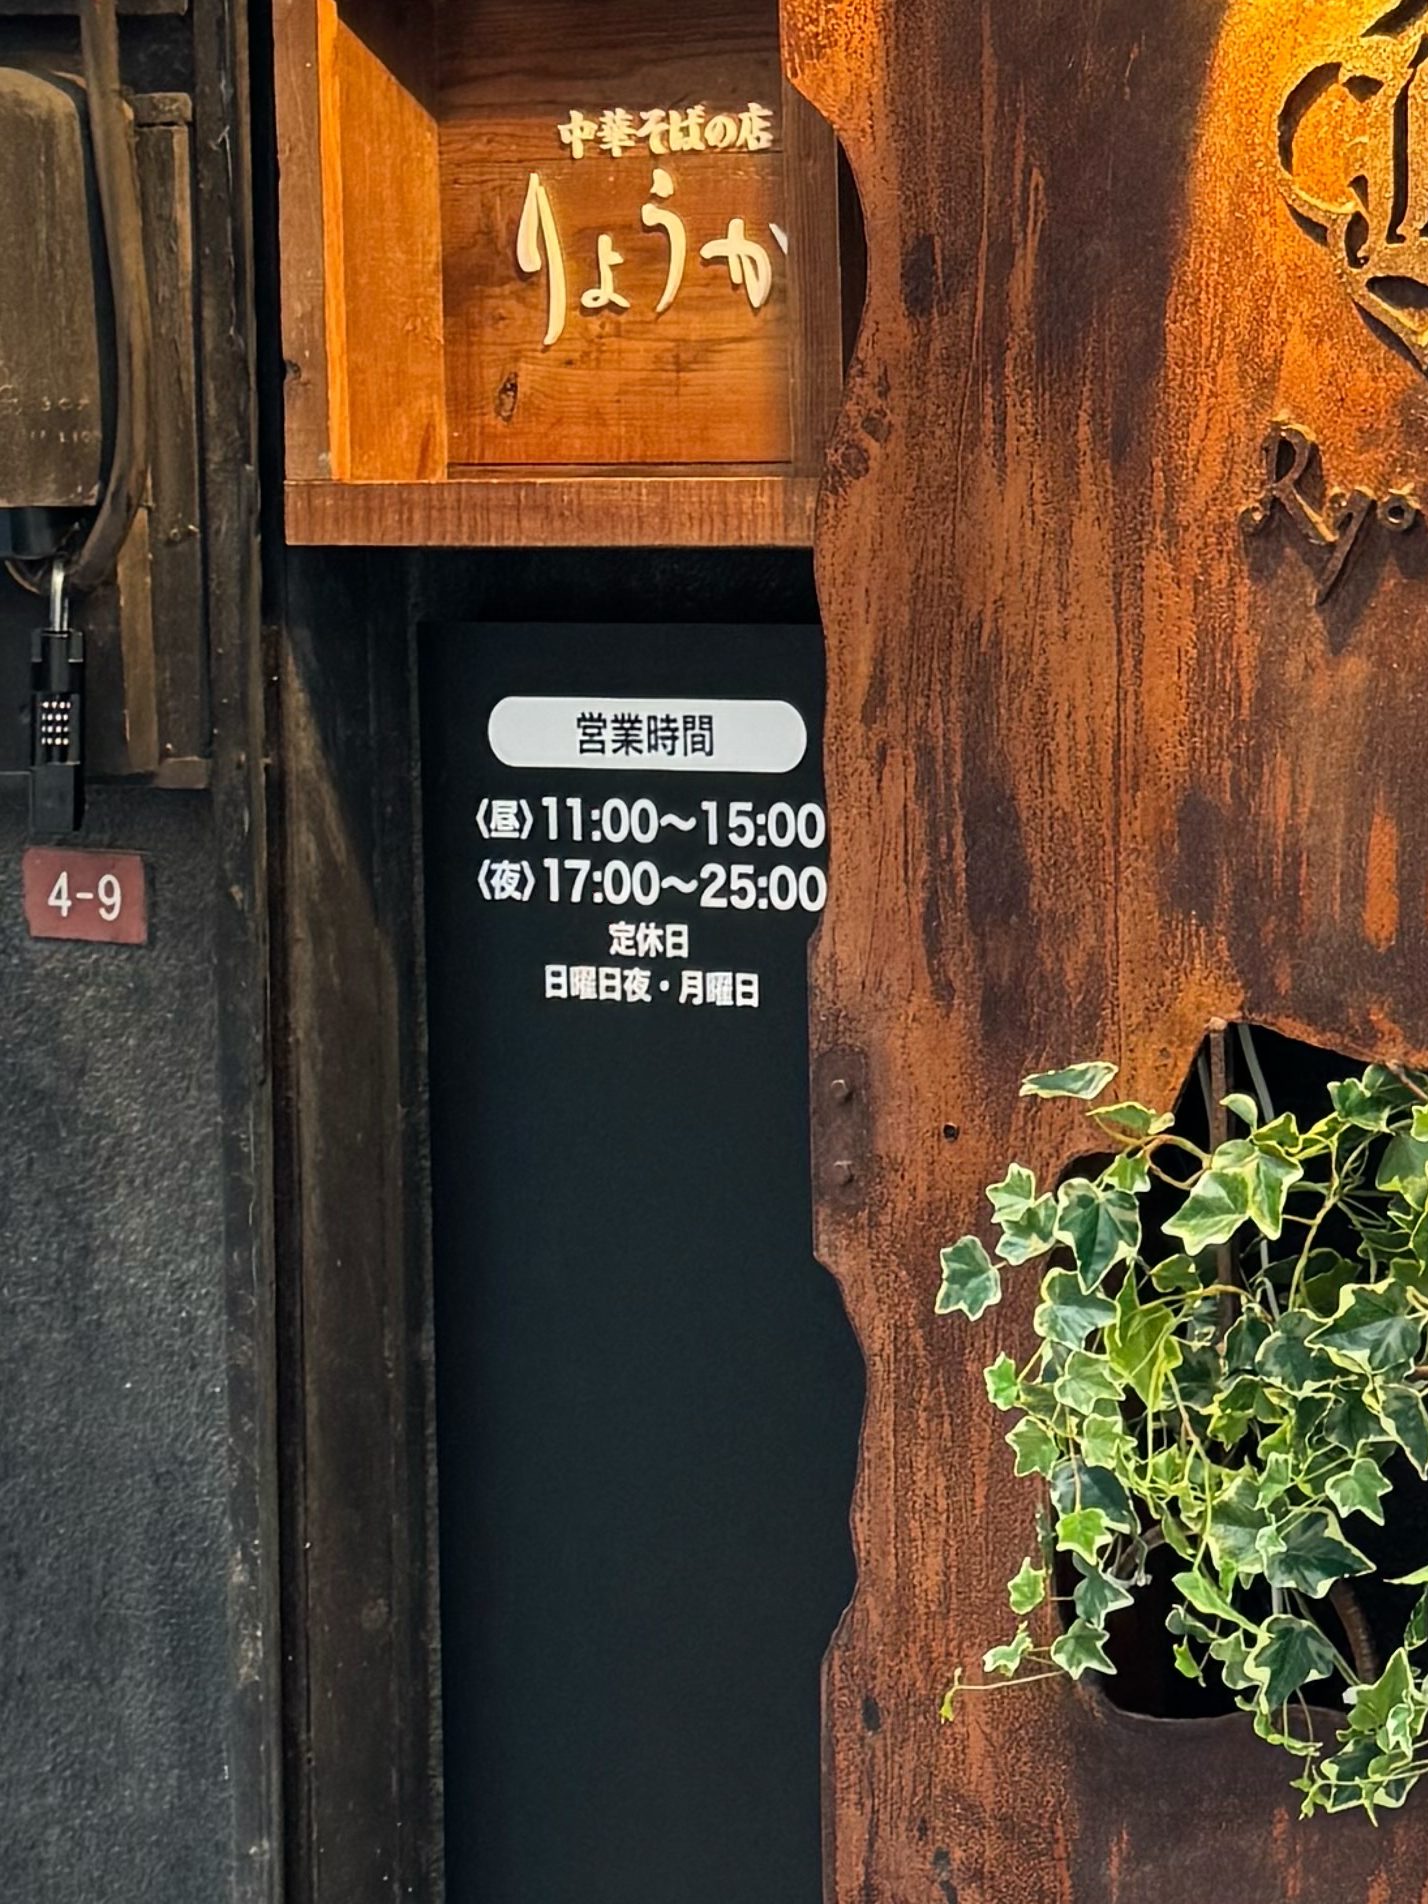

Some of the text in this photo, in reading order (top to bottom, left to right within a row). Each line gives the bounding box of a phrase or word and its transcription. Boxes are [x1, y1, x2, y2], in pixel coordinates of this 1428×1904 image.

[556, 102, 775, 159] 中華そばの店
[575, 710, 715, 759] 営業時間
[47, 870, 122, 922] 4-9
[608, 920, 690, 959] 定休日
[544, 963, 760, 1008] 日曜日夜・月曜日
